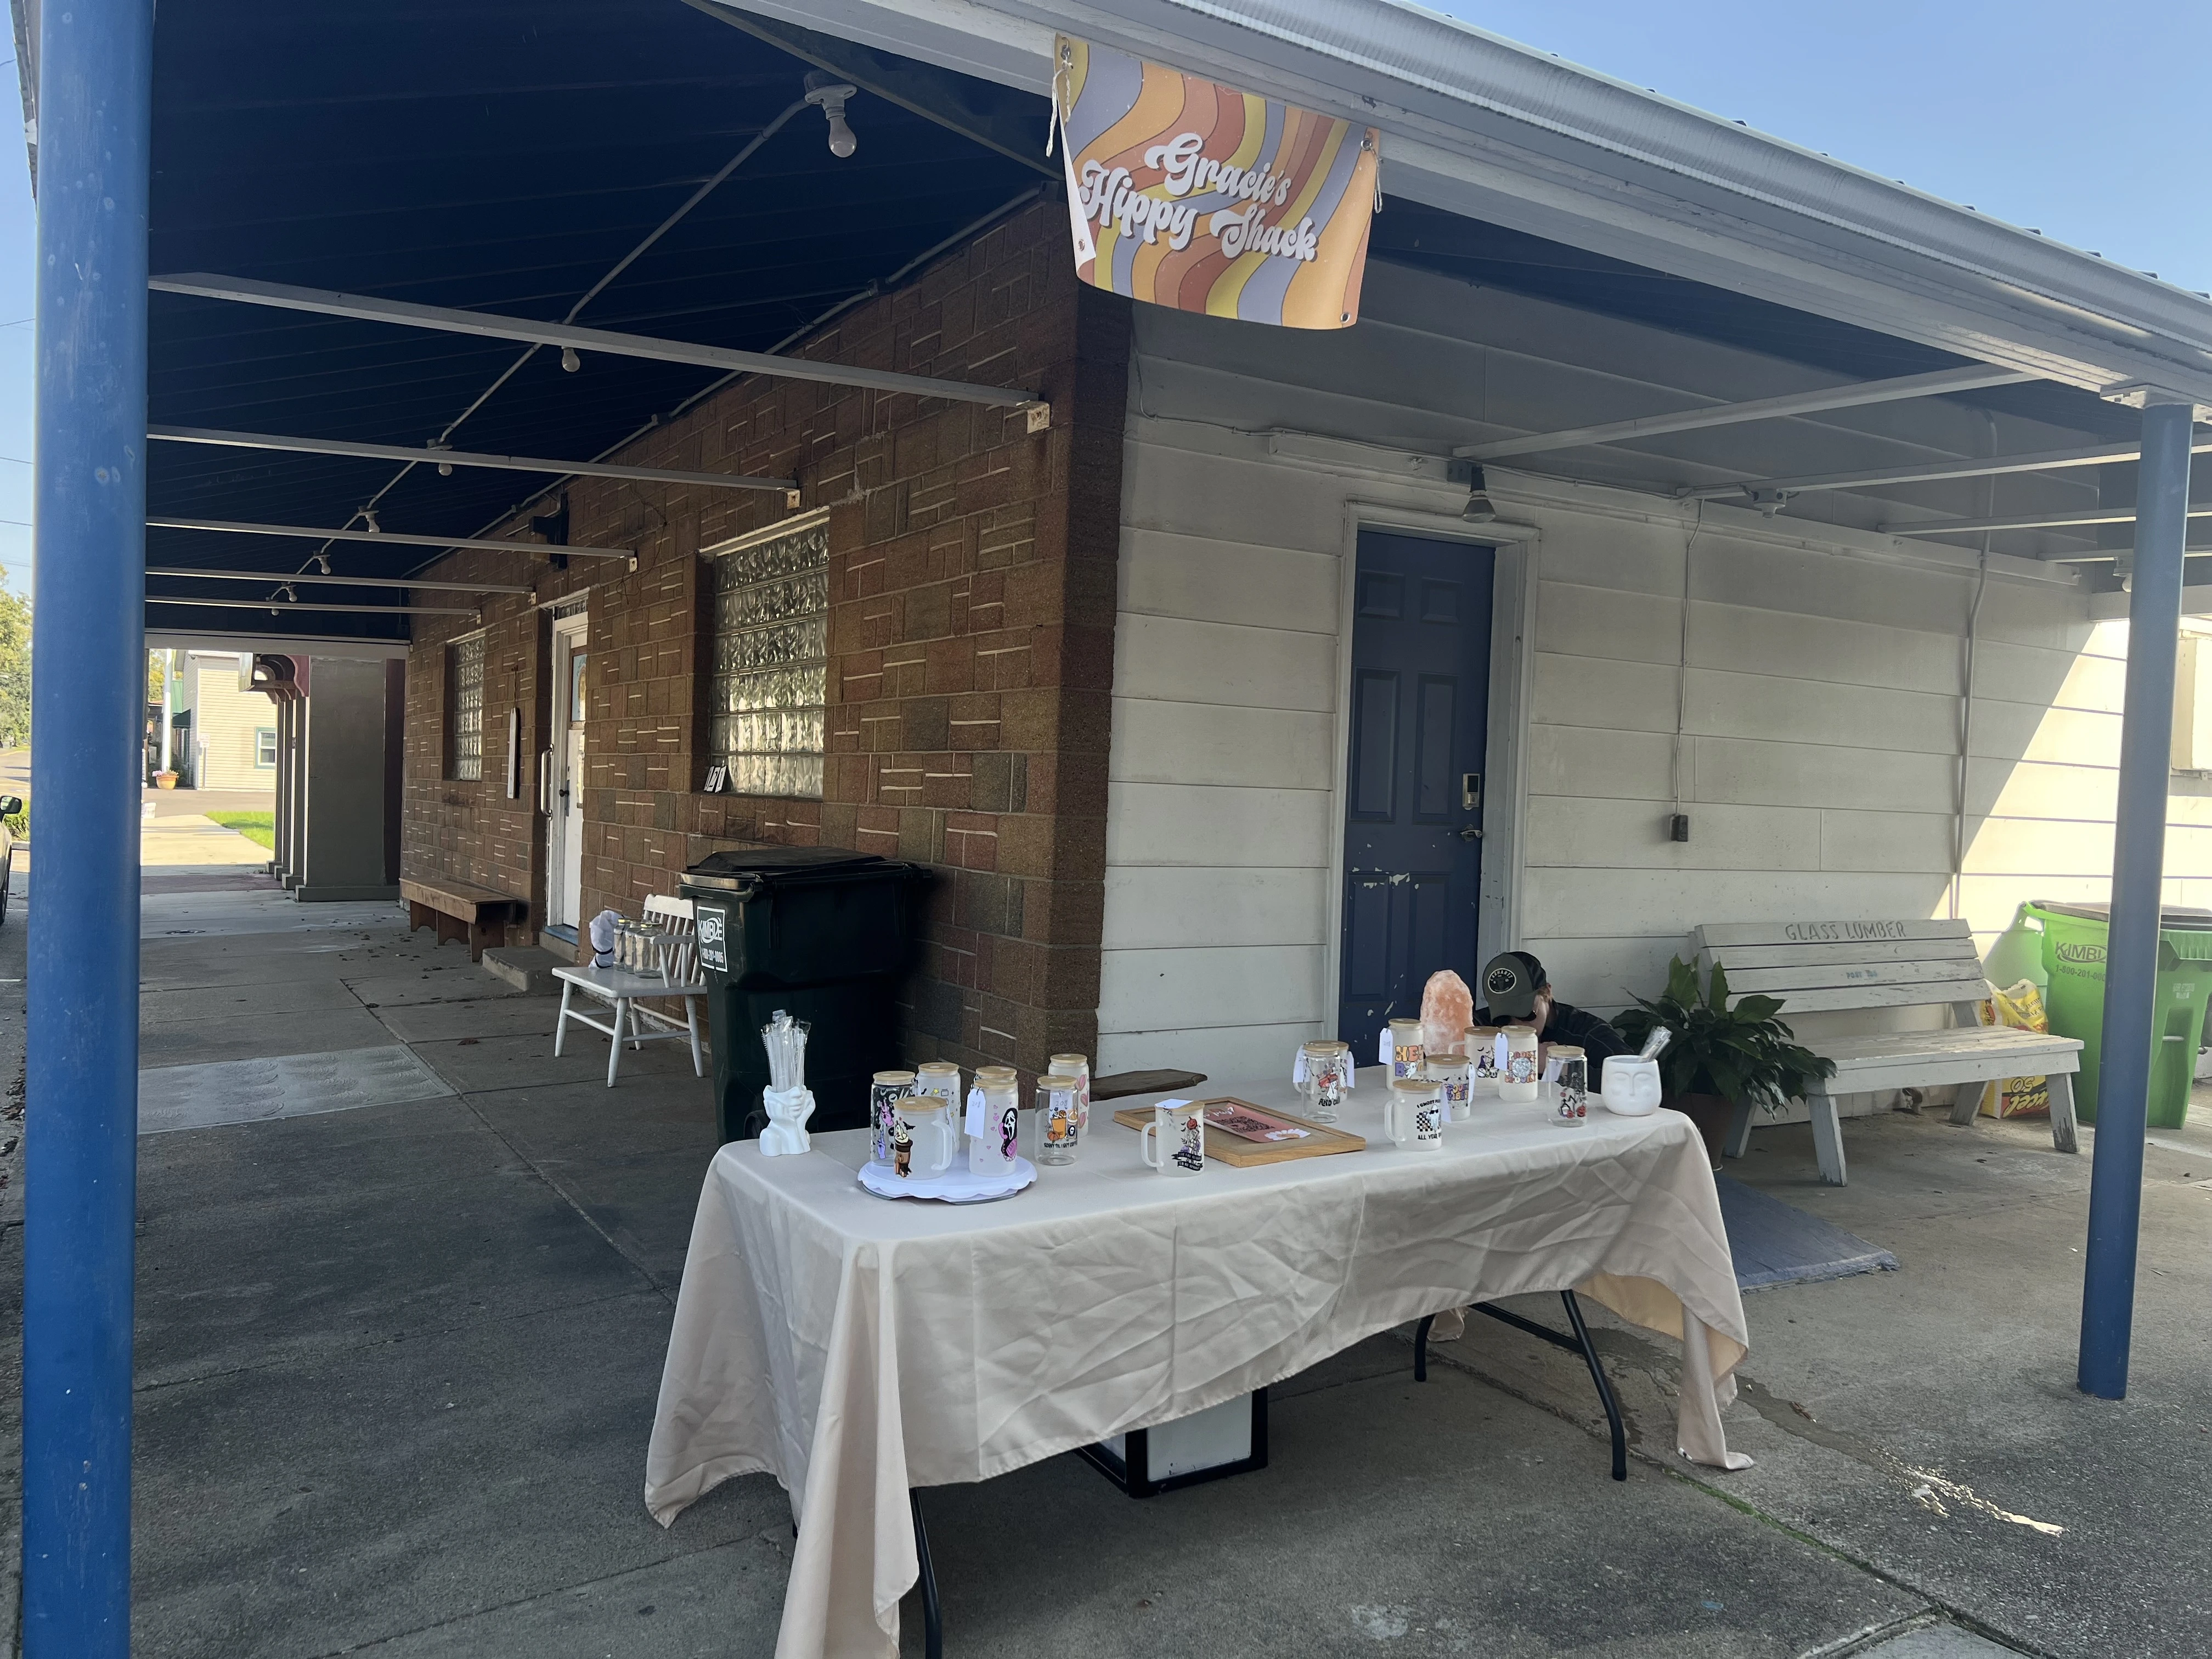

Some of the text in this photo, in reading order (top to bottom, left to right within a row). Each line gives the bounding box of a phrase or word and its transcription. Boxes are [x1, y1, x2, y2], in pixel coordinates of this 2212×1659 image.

[1144, 133, 1291, 206] Gracie's
[1078, 159, 1317, 261] Hippy Shack
[698, 918, 723, 943] KIMBLE
[1785, 921, 1906, 940] GLASS LUMBER
[2055, 941, 2107, 962] KIMBL
[2056, 964, 2106, 982] 1-800-201-000
[1507, 1050, 1536, 1062] POOKY
[1318, 1098, 1332, 1107] AND
